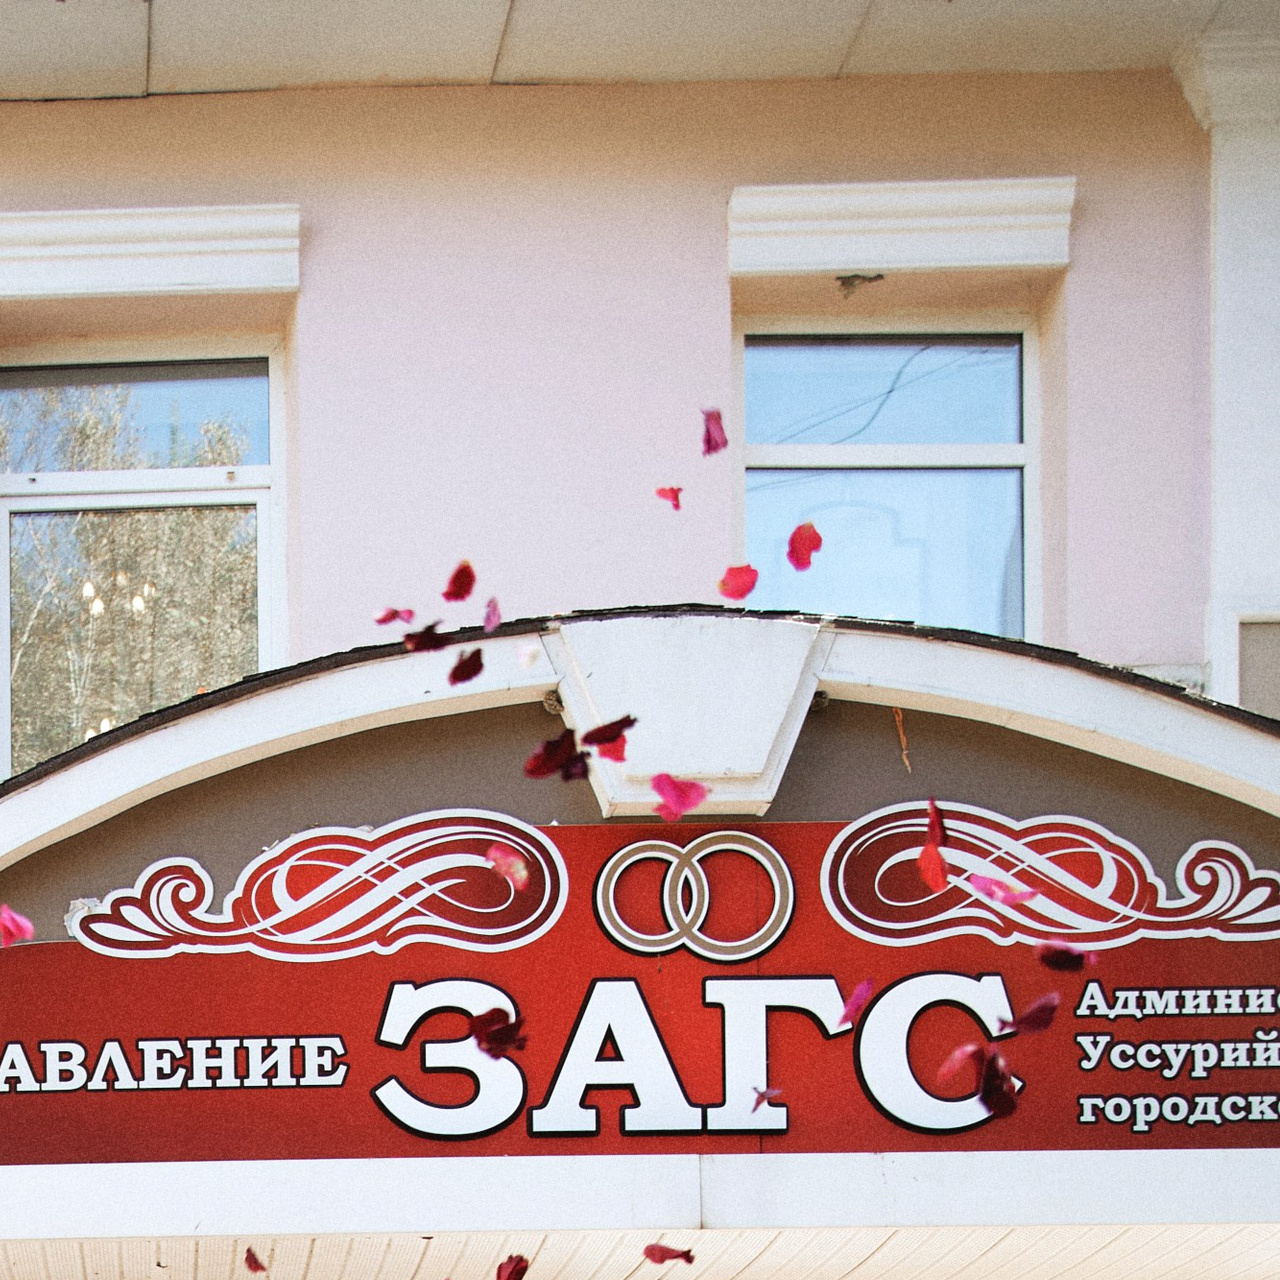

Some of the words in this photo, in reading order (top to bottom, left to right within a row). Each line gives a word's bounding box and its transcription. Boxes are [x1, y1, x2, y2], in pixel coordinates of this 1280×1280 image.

[1075, 981, 1280, 1019] Админи
[373, 972, 1024, 1137] ЗАГС
[1076, 1030, 1280, 1078] Уссурий
[1078, 1095, 1280, 1132] городск
